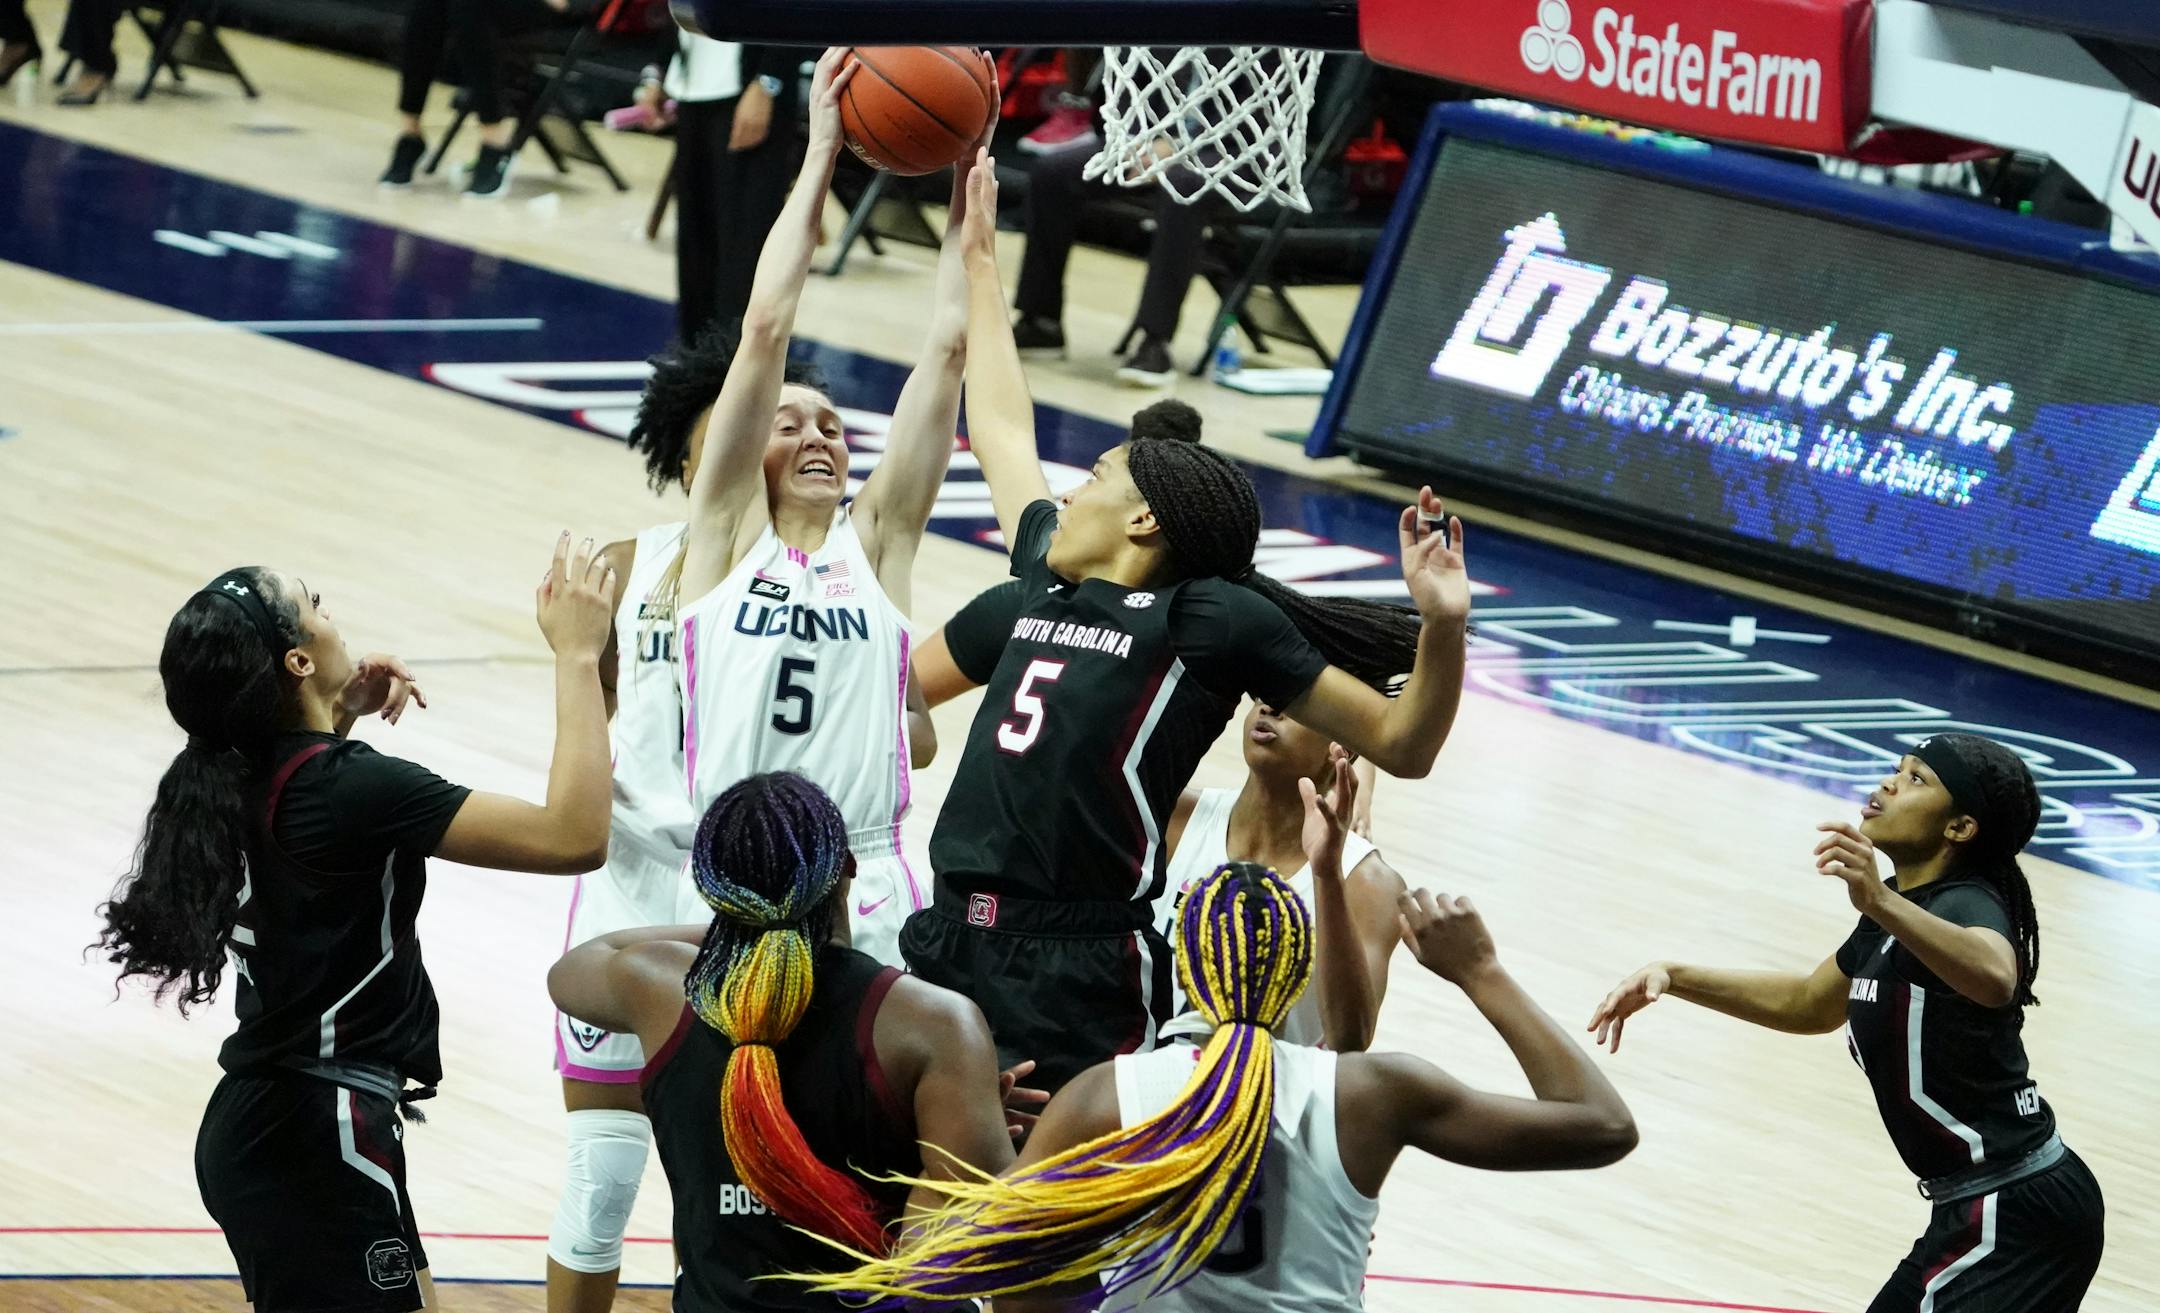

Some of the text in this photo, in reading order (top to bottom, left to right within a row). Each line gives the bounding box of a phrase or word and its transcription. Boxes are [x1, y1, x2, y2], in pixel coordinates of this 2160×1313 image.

[1590, 274, 2015, 452] Bozzuto's Inc.
[754, 581, 789, 596] BLM
[1123, 592, 1157, 609] SEC
[734, 601, 869, 642] UCONN
[1051, 622, 1134, 659] CAROLINA
[771, 656, 817, 736] 5
[996, 657, 1067, 756] 5
[719, 1183, 777, 1215] BOS
